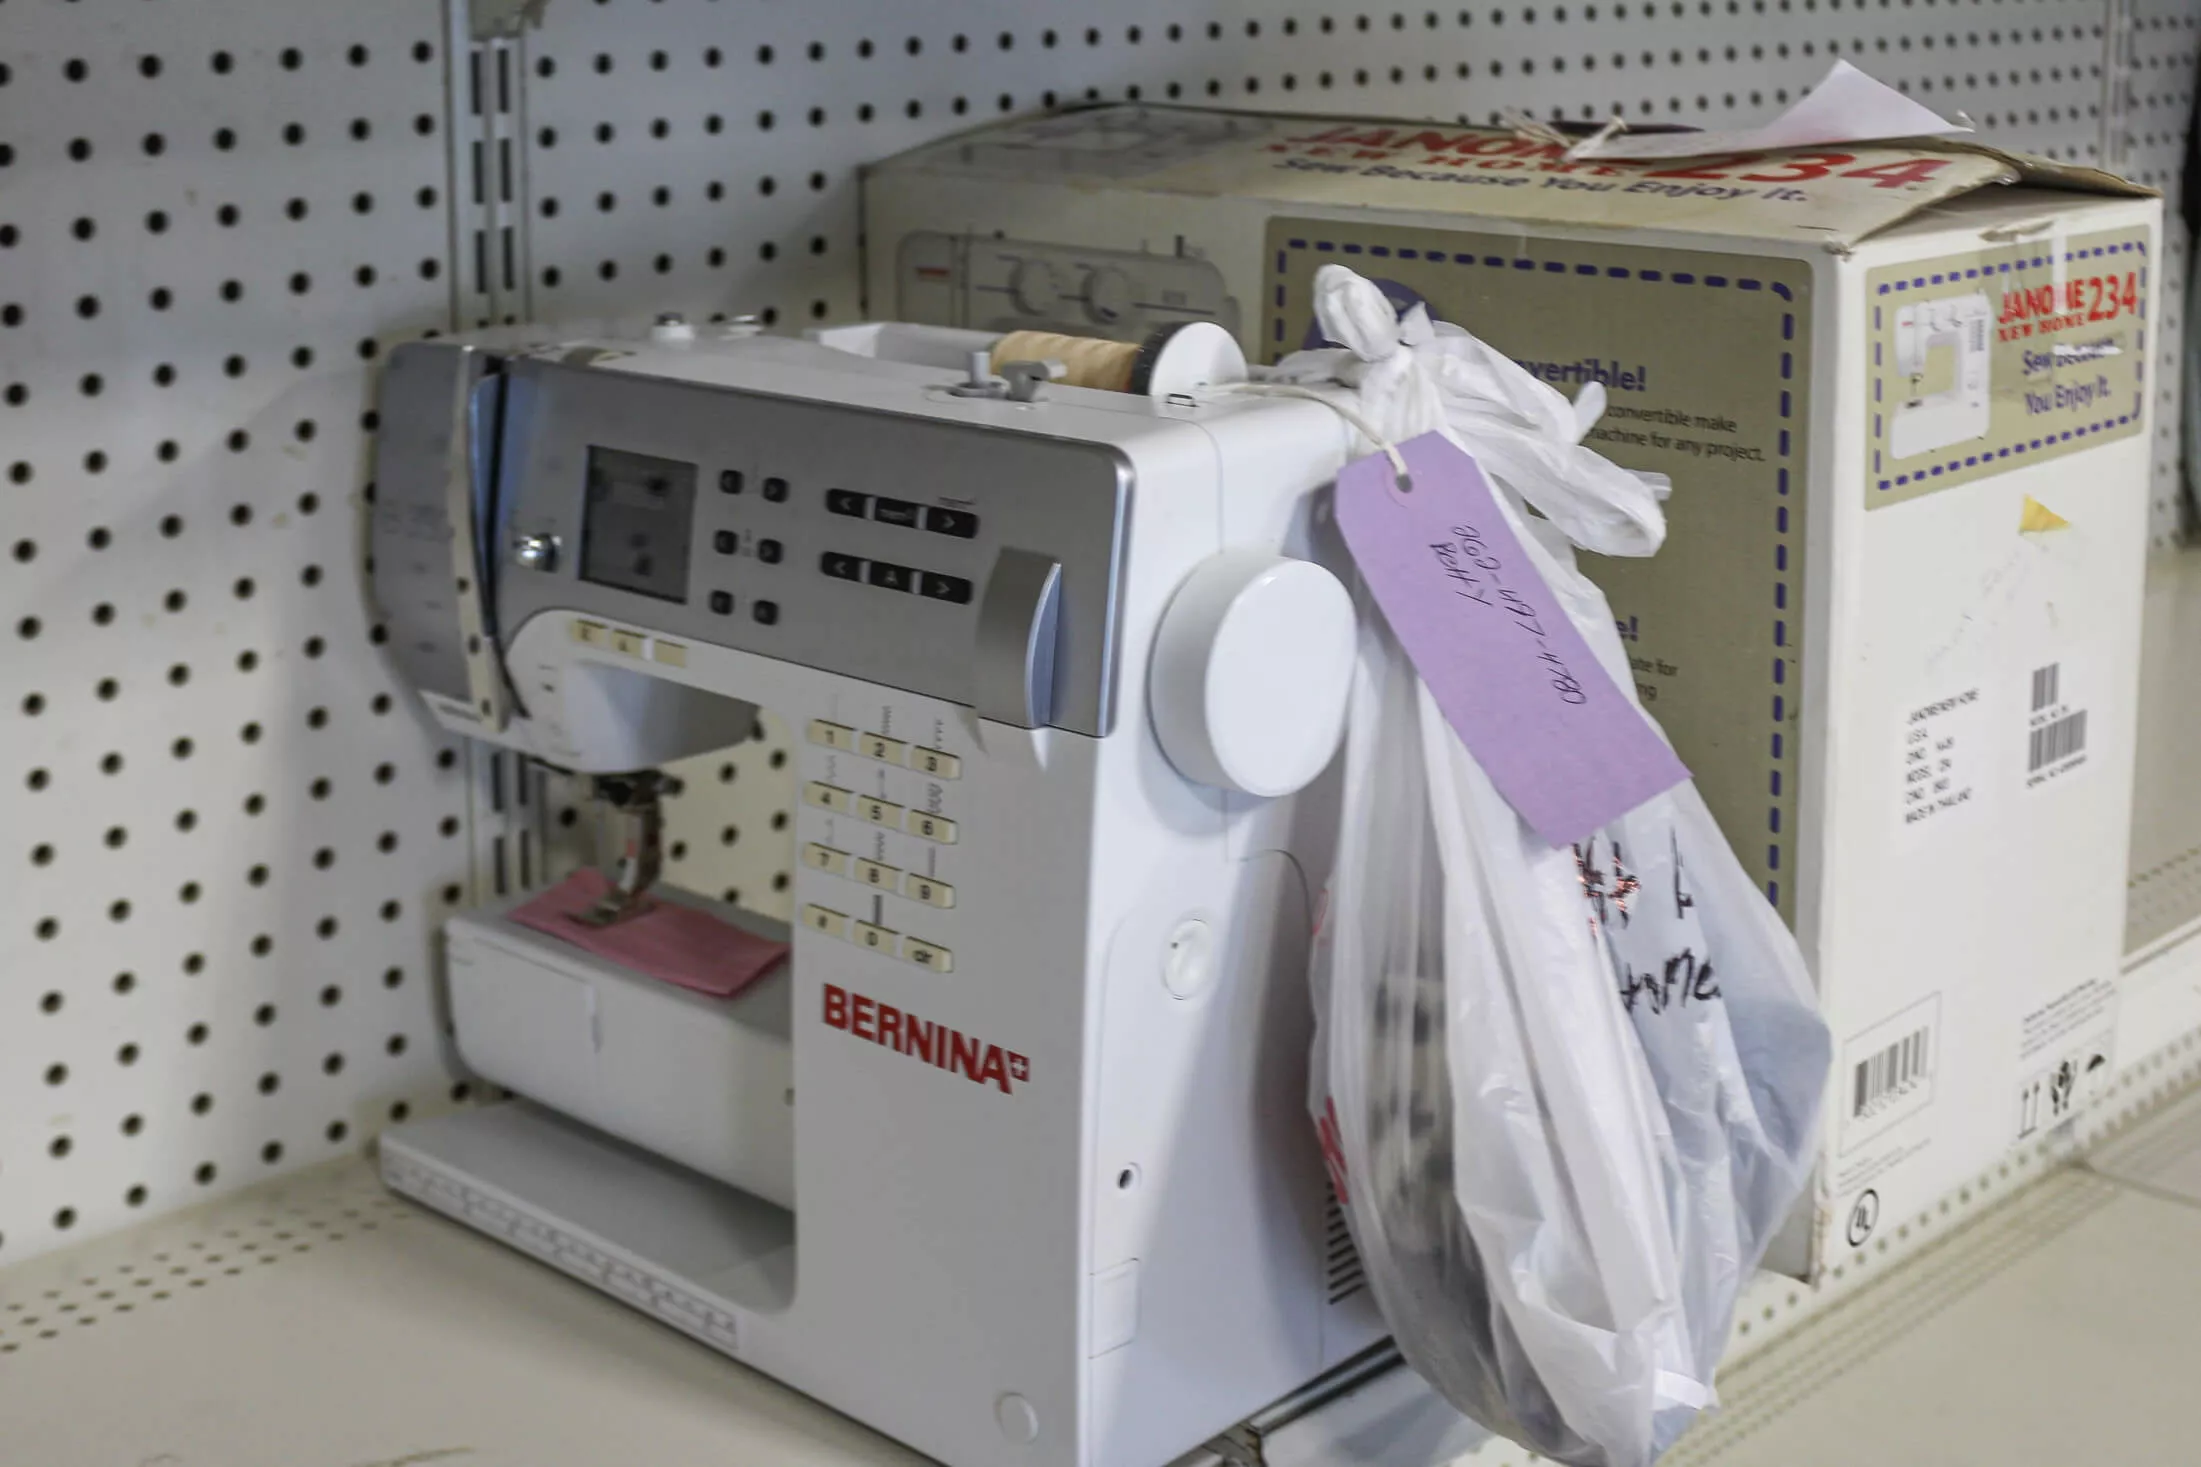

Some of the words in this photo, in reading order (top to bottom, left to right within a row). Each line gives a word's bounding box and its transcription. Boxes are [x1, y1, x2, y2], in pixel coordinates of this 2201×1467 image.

[1285, 126, 1653, 166] JANOM
[1642, 152, 1953, 188] 234
[1417, 155, 1618, 177] HOME
[1272, 158, 1357, 173] Sew
[1360, 165, 1530, 186] Because
[1540, 177, 1618, 192] You
[1622, 181, 1755, 200] Enjoy
[2087, 271, 2139, 322] 234
[1514, 357, 1647, 392] vertible!
[2055, 380, 2093, 413] Enjoy
[1607, 403, 1691, 428] convertible
[1694, 415, 1737, 434] make
[1650, 431, 1671, 449] for
[1675, 439, 1701, 456] any
[874, 741, 885, 758] 2
[870, 804, 882, 821] 5
[822, 982, 1014, 1095] BERNINA
